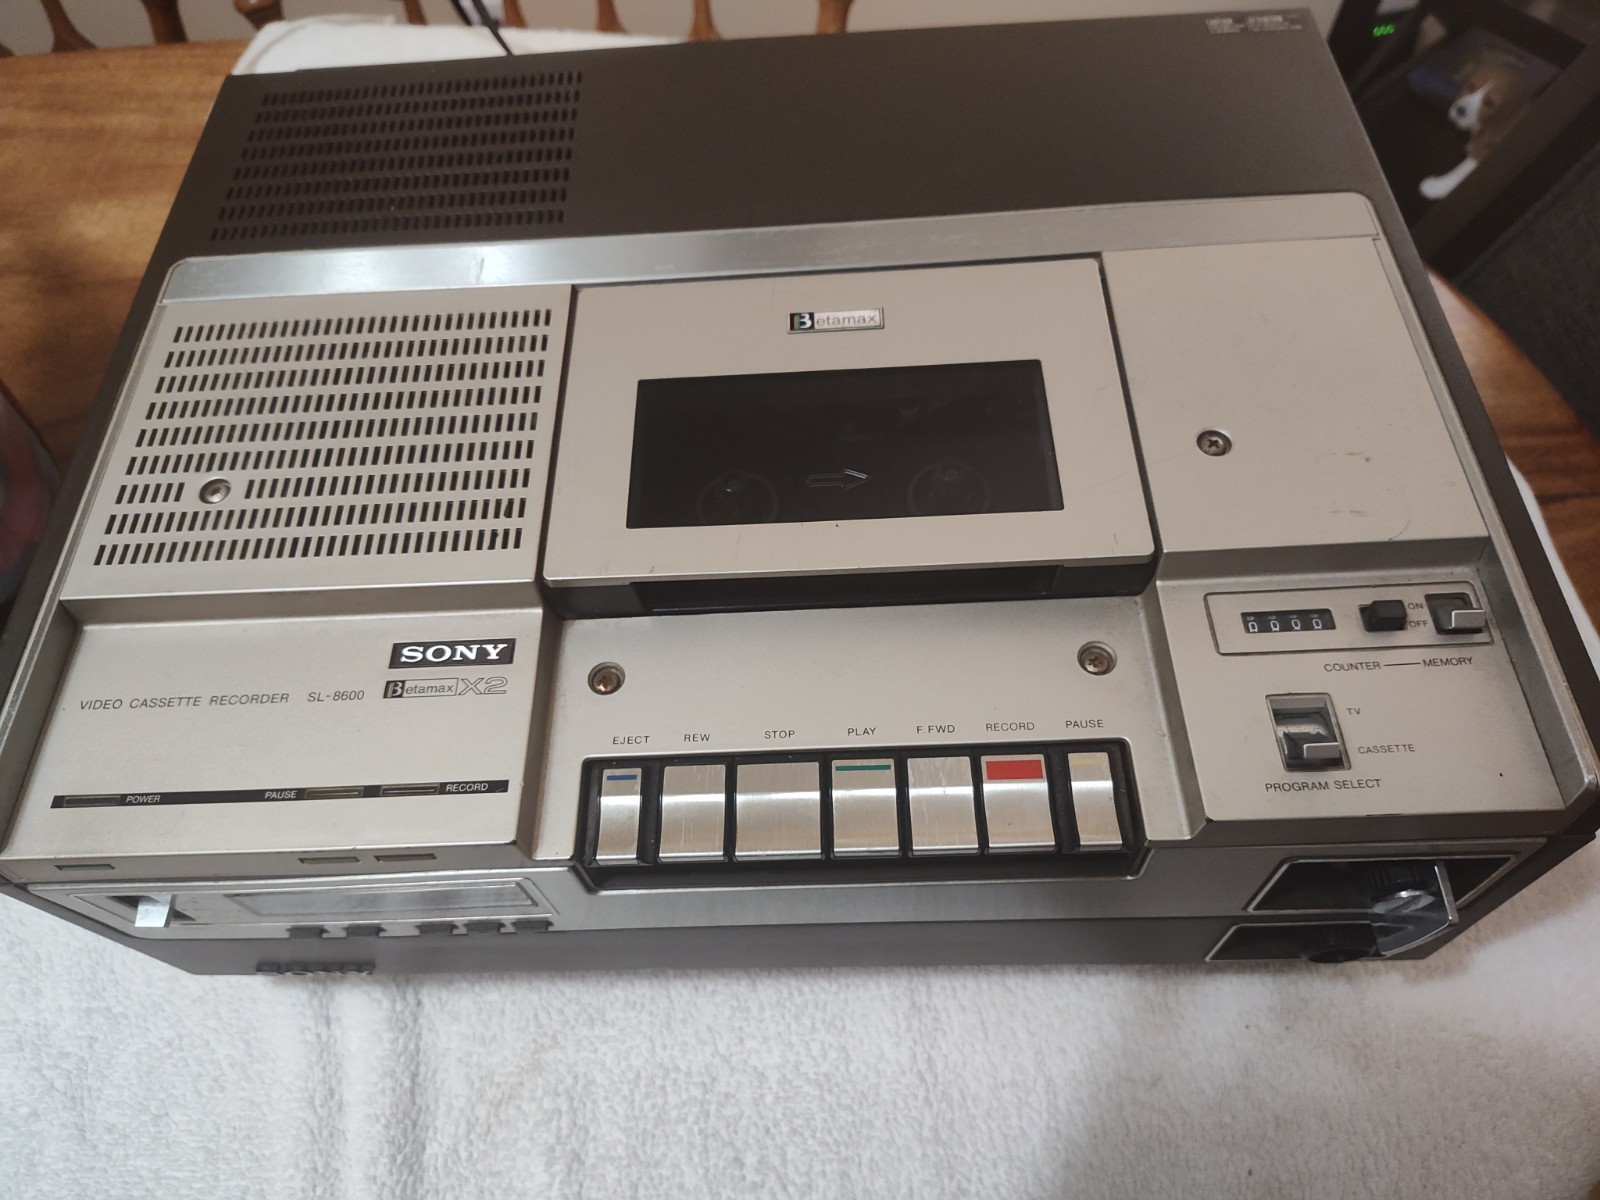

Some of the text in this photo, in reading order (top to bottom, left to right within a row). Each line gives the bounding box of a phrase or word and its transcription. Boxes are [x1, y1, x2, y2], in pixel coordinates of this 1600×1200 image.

[1407, 602, 1424, 611] ON
[1408, 619, 1429, 629] OFF
[400, 643, 508, 662] SONY
[1323, 656, 1474, 672] COUNTER MEMORY
[458, 676, 509, 696] X2
[79, 690, 365, 710] VIDEO CASSETTE RECORDER SL-8600
[985, 721, 1035, 732] RECORD
[1065, 719, 1105, 729] PAUSE
[764, 730, 796, 739] STOP
[847, 727, 877, 736] PLAY
[612, 735, 650, 745] EJECT
[683, 733, 711, 742] REW
[1357, 744, 1416, 754] CASSETTE
[445, 783, 489, 792] RECORD
[1265, 779, 1382, 792] PROGRAM SELECT
[126, 795, 161, 804] POWER
[264, 790, 298, 799] PAUSE
